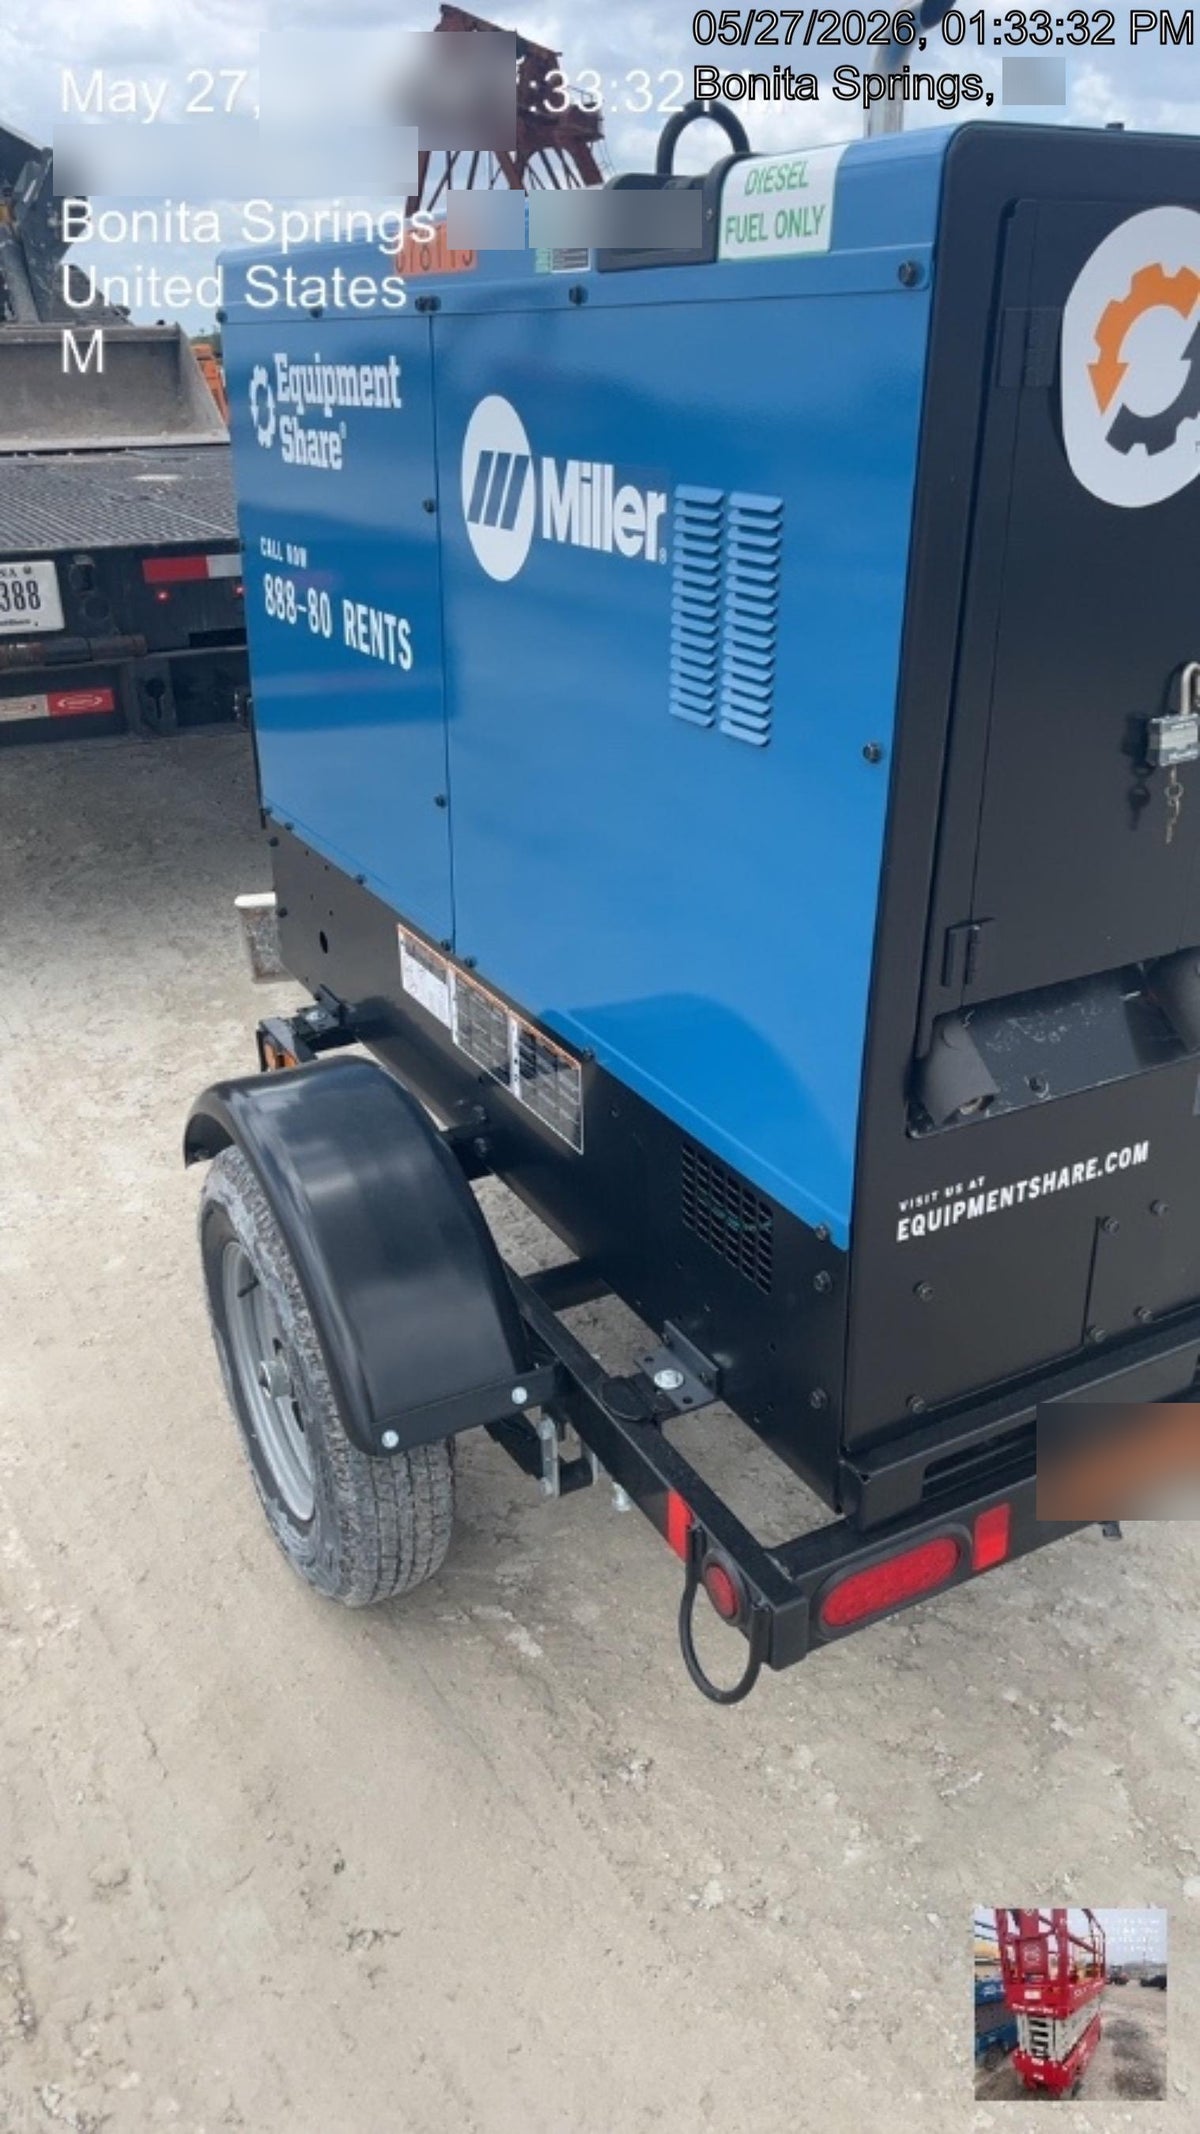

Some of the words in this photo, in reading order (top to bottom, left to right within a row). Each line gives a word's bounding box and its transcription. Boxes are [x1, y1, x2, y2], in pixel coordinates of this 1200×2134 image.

[744, 161, 809, 196] DIESEL
[725, 210, 768, 244] FUEL
[774, 205, 826, 239] ONLY
[274, 353, 402, 418] Equipment
[264, 573, 332, 639] 888-80
[343, 599, 413, 670] RENTS
[896, 1140, 1149, 1243] EQUIPMENTSHARE.COM
[899, 1190, 938, 1212] VISIT
[945, 1184, 963, 1197] US
[968, 1175, 986, 1190] AT
